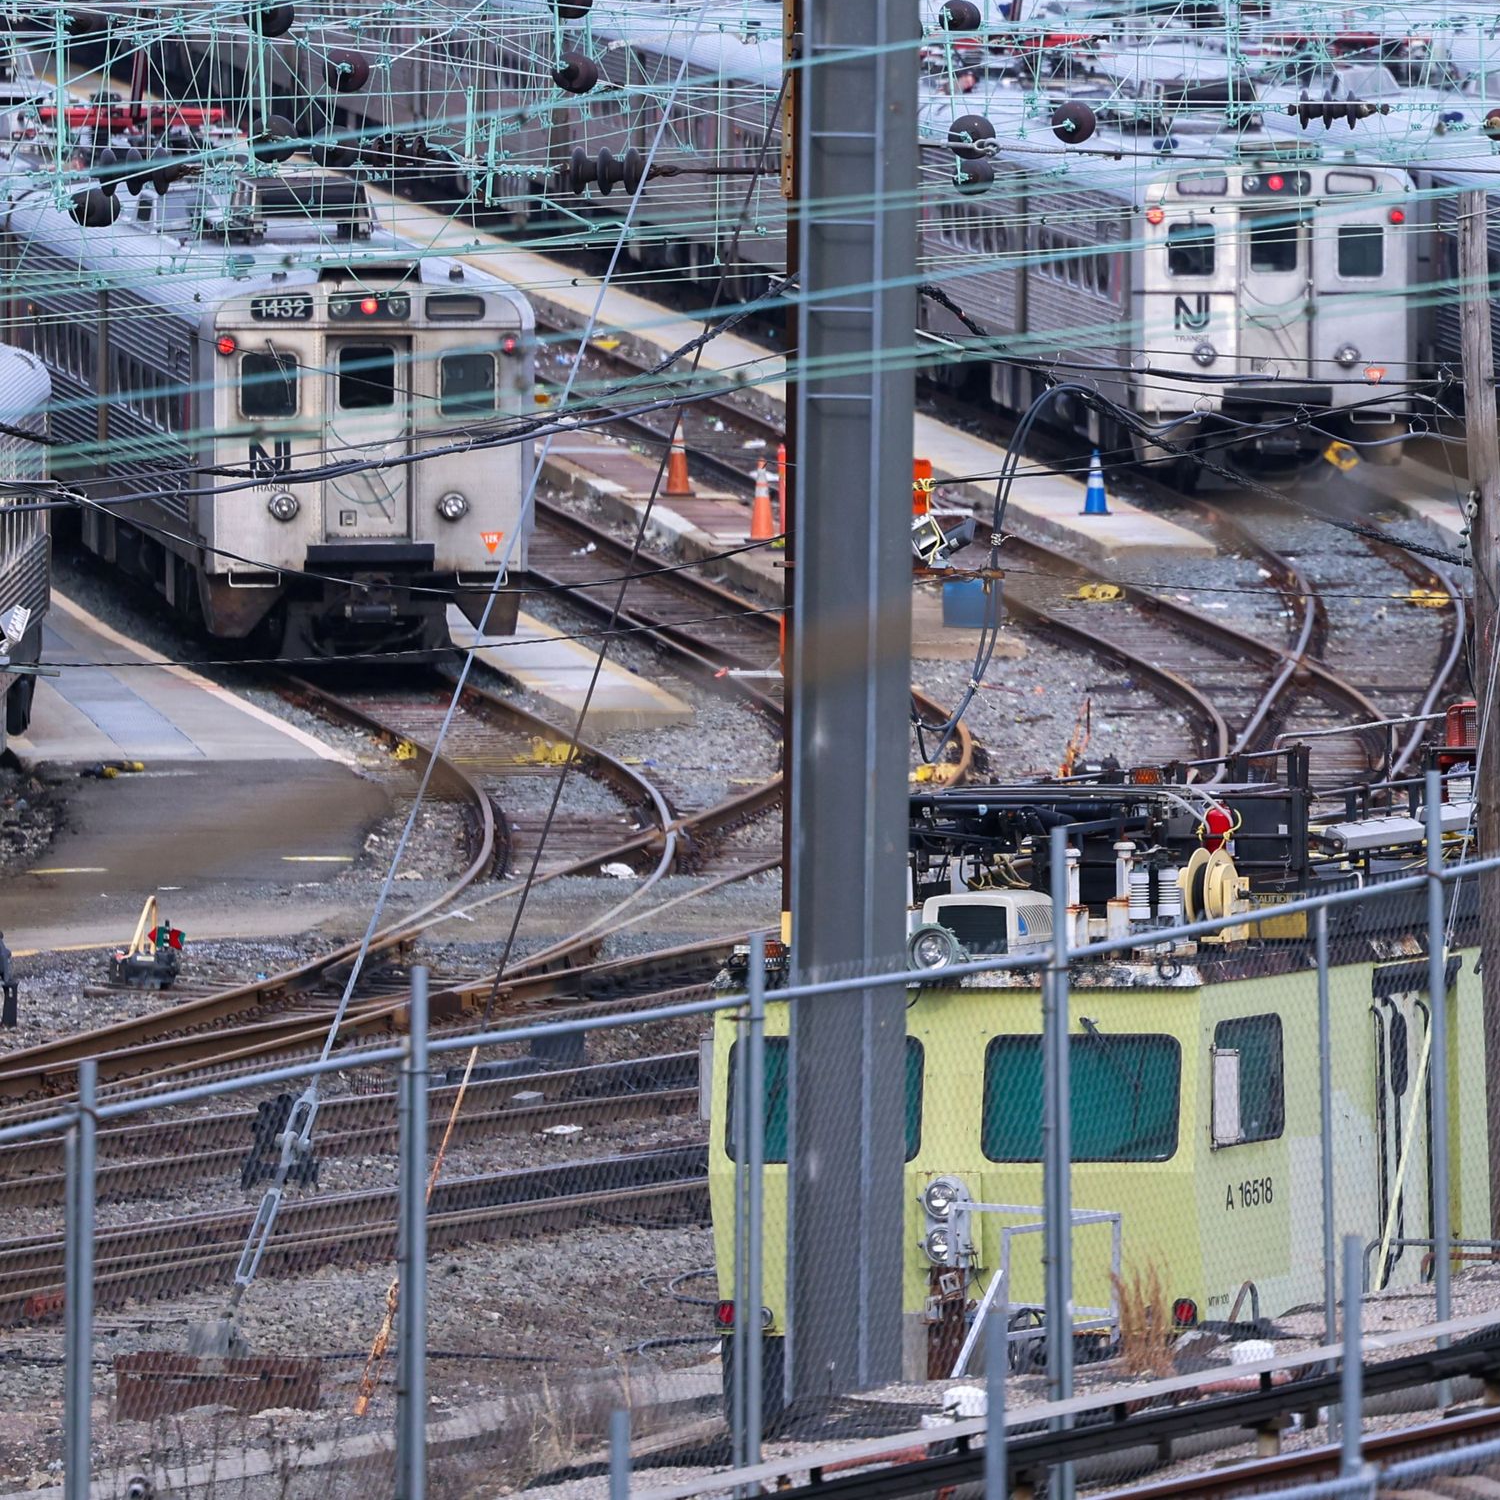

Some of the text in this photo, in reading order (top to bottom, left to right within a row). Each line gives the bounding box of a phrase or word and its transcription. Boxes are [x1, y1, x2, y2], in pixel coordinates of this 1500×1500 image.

[259, 299, 306, 318] 1432
[1174, 293, 1210, 332] NJ
[249, 435, 292, 476] NJ
[252, 483, 291, 493] TRANSIT
[1226, 1177, 1273, 1211] A 16518
